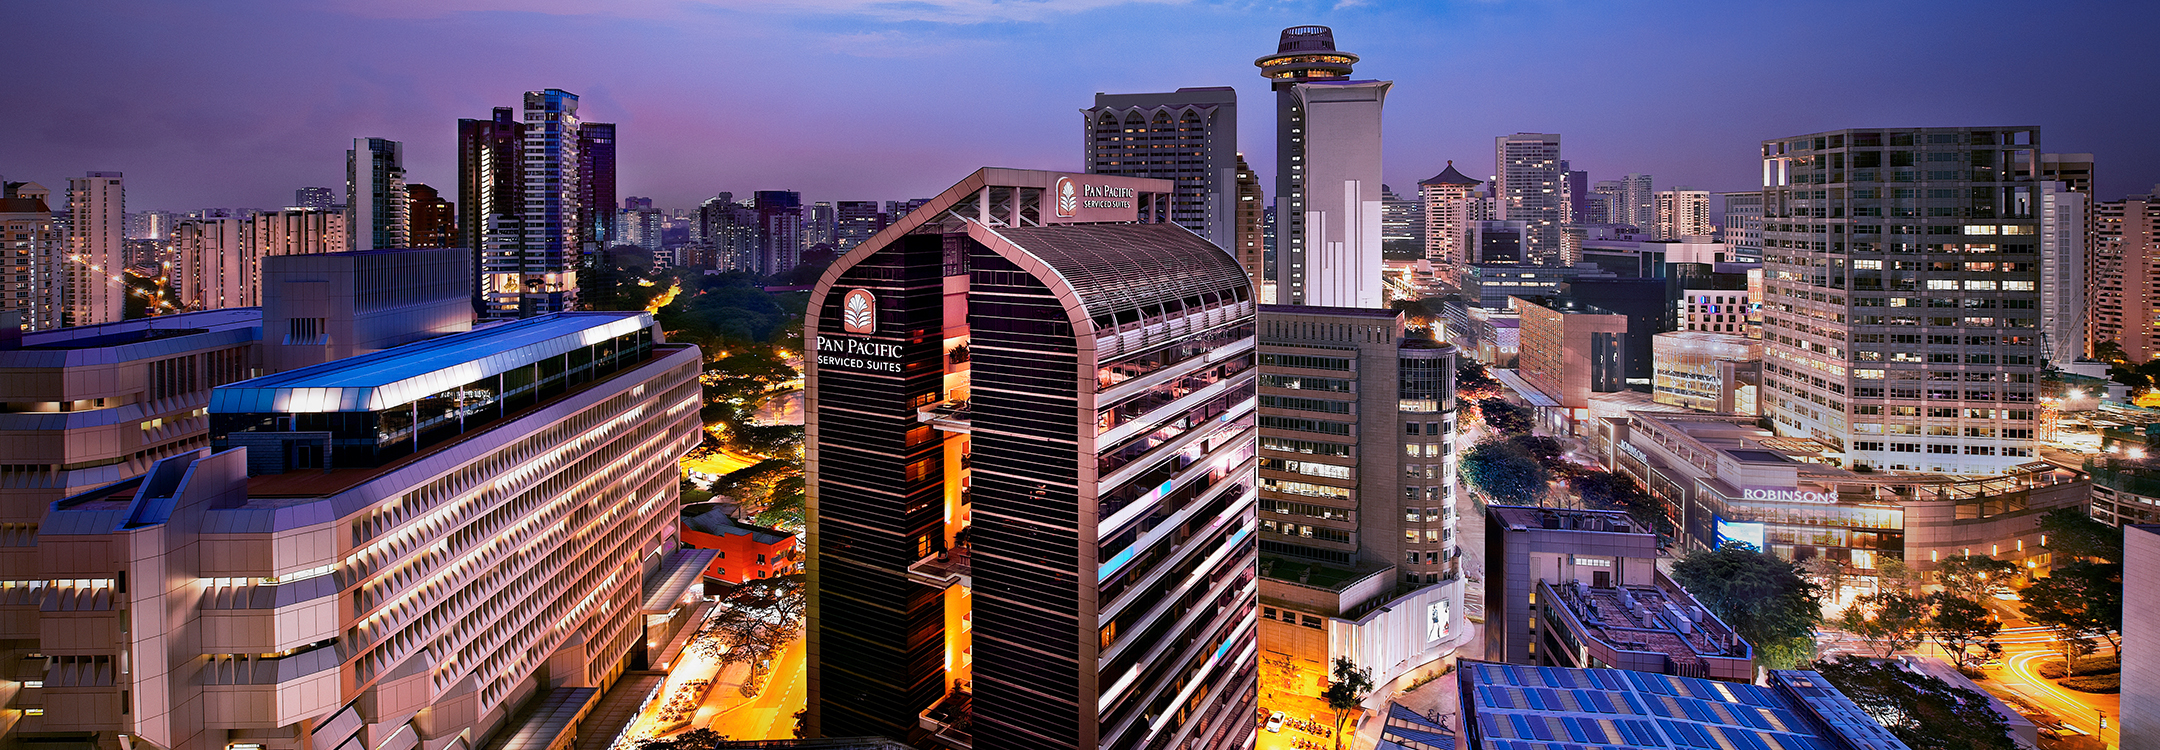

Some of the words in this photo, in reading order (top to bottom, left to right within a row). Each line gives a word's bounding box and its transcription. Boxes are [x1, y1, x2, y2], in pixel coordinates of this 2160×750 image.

[1083, 184, 1102, 197] PAN
[1103, 184, 1134, 198] PACIFIC
[1083, 200, 1112, 208] SERVICED
[1112, 200, 1131, 208] SUITES
[816, 336, 844, 352] PAN
[847, 338, 903, 359] PACIFIC
[817, 355, 864, 369] SERVICED
[866, 360, 901, 373] SUITES
[1743, 488, 1839, 504] ROBINSONS
